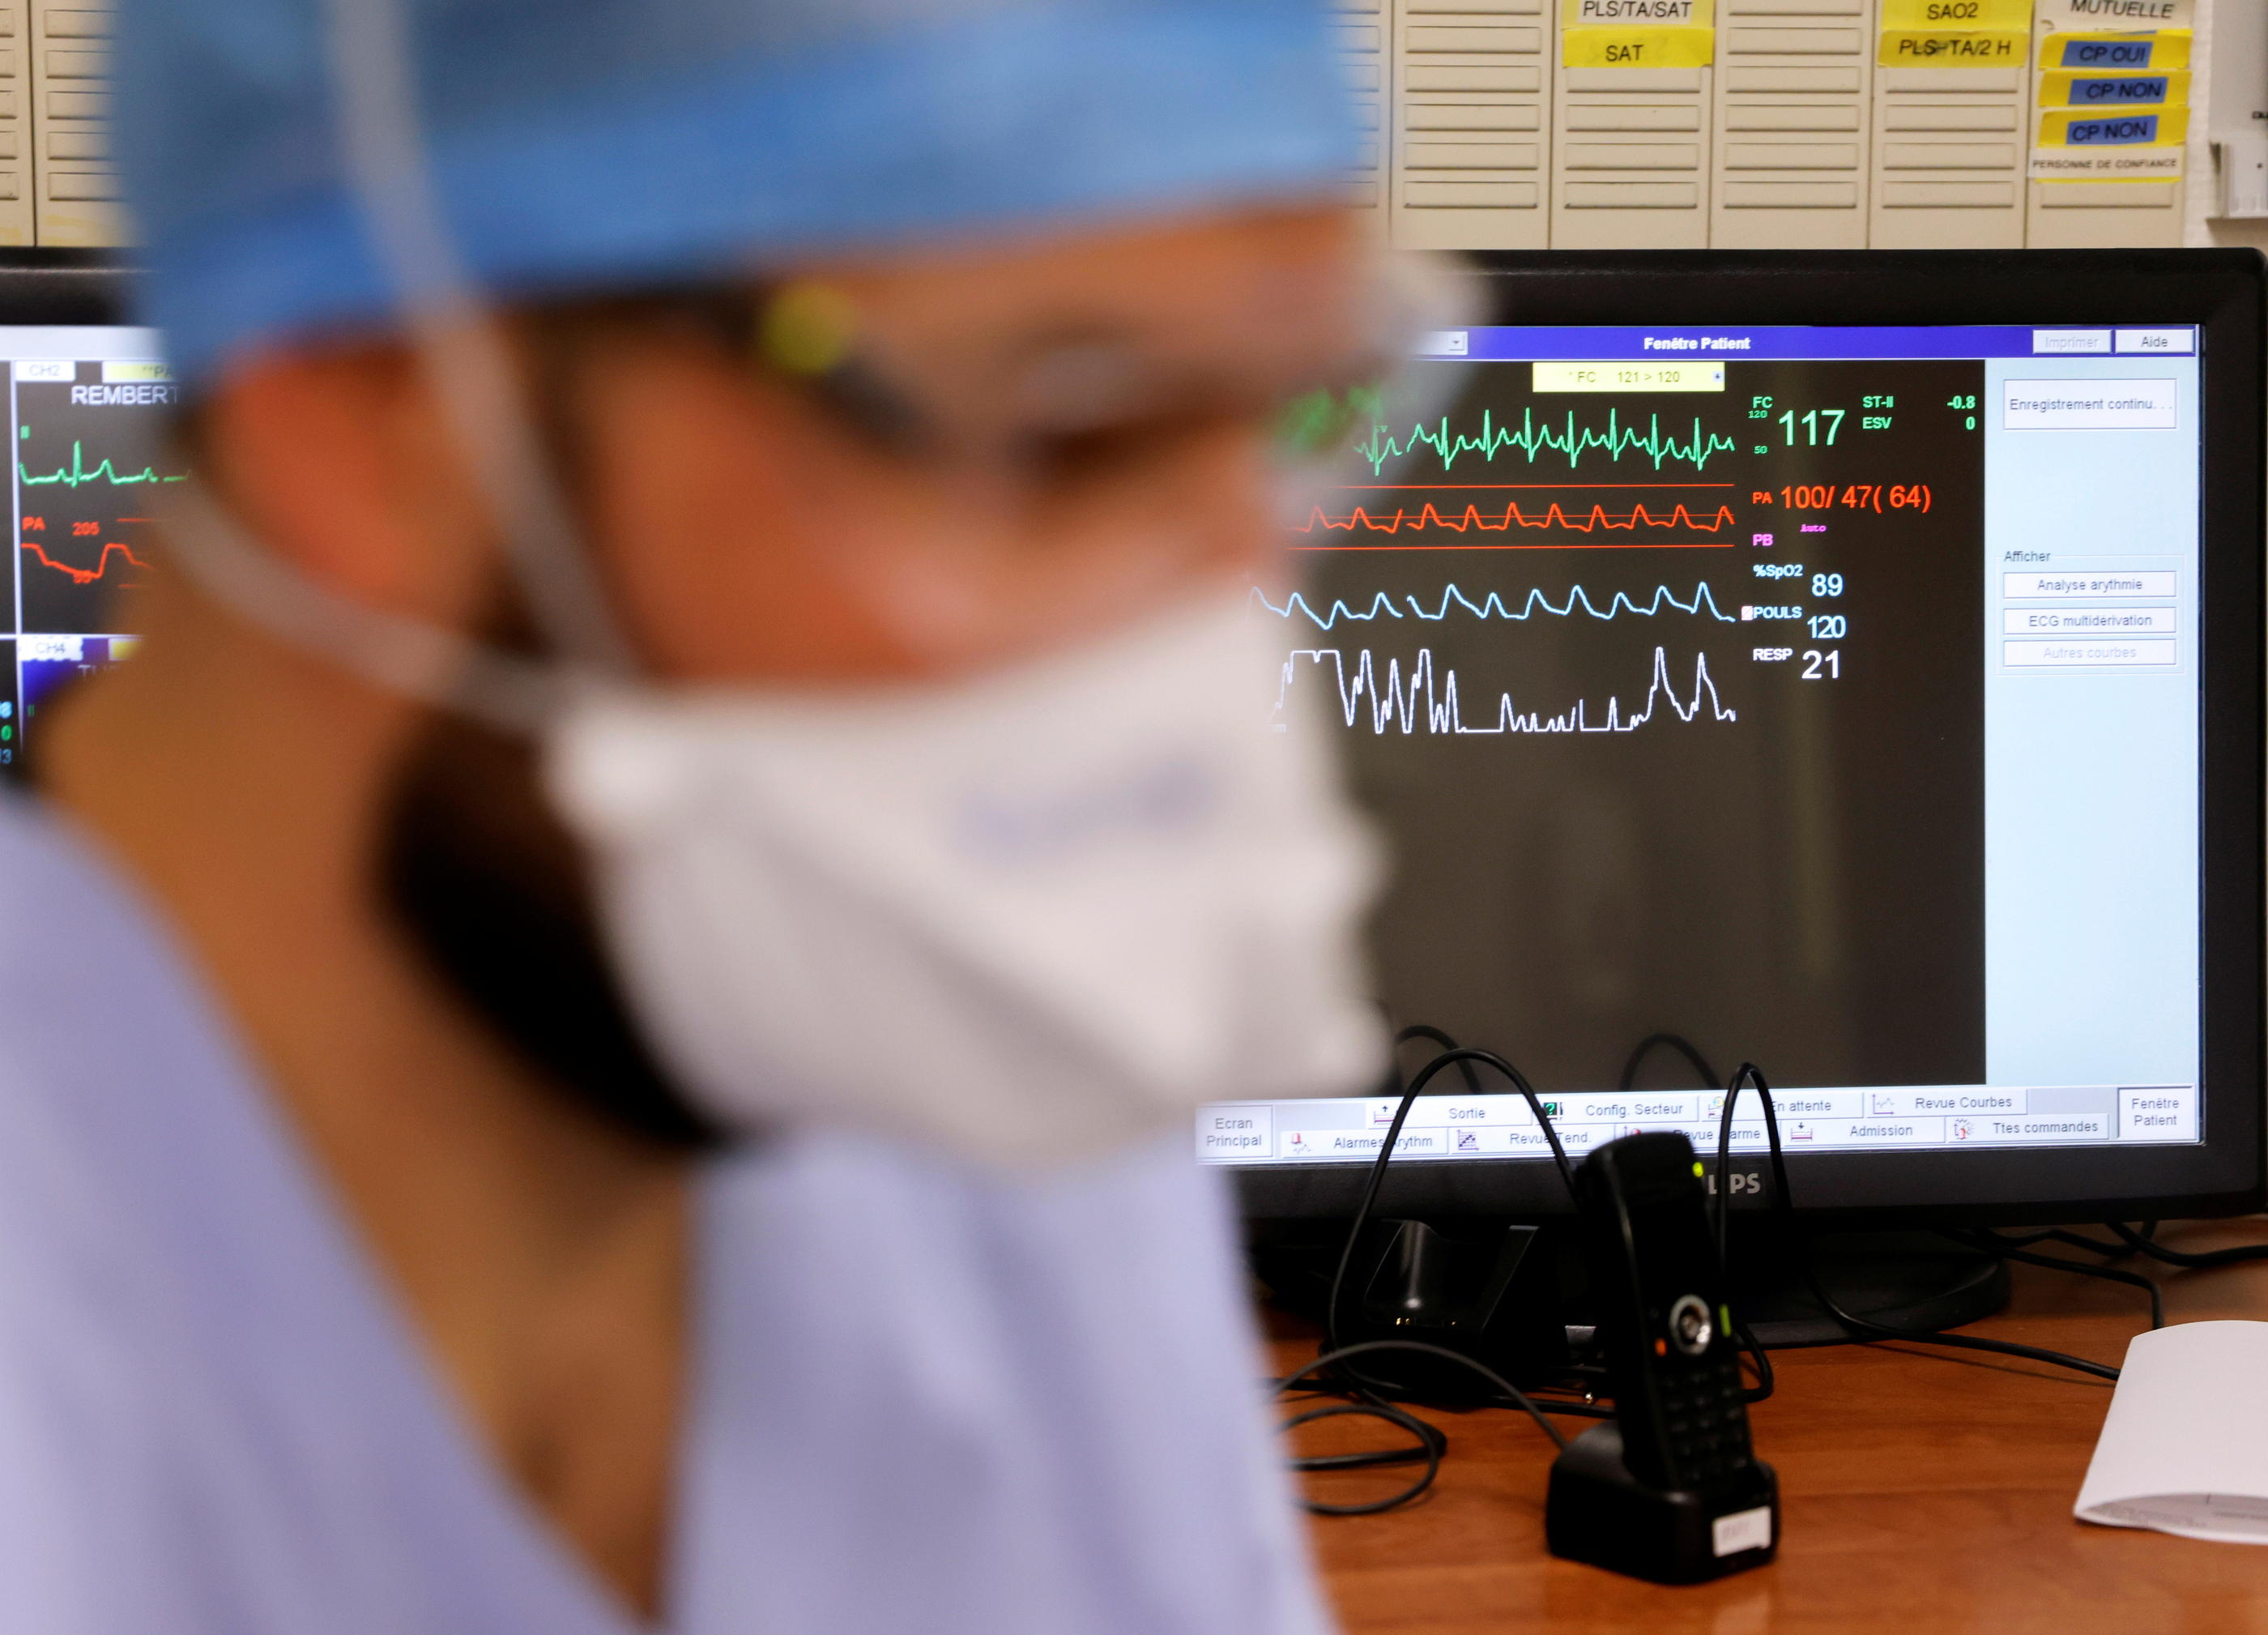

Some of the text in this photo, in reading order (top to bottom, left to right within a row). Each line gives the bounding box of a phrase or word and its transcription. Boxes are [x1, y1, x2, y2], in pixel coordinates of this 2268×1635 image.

[1583, 1, 1693, 17] PLS/TA/SAT
[1927, 2, 1978, 19] SAO2
[2070, 0, 2174, 19] MUTUELLE
[1605, 45, 1643, 62] SAT
[1997, 41, 2011, 55] H
[2079, 46, 2146, 62] CP OUI
[2087, 82, 2162, 99] CP NON
[2072, 122, 2147, 141] CP NON
[2033, 158, 2176, 169] PERSONNE DE CONFIANCE
[1701, 337, 1751, 350] Patient
[2045, 337, 2099, 350] Imprimer
[2141, 336, 2168, 348] Aide
[29, 364, 60, 376] CH2
[1577, 371, 1596, 382] FC
[1618, 371, 1639, 382] 121
[1659, 371, 1681, 382] 120
[1752, 396, 1773, 408] FC
[1947, 395, 1976, 409] -0.8
[2010, 399, 2104, 412] Enregistrement
[1748, 410, 1767, 418] 120
[1779, 409, 1845, 446] 117
[1863, 416, 1975, 430] ESV 0
[1754, 446, 1767, 454] 50
[1752, 492, 1772, 504] PA
[22, 516, 45, 531] PA
[1753, 534, 1773, 546] PB
[2004, 551, 2051, 562] Afficher
[1753, 565, 1844, 596] %SpO2 89
[2038, 578, 2142, 593] Analyse arythmie
[1753, 607, 1846, 638] POULS 120
[2029, 616, 2059, 627] ECG
[2044, 647, 2137, 659] Autres courbes
[1753, 649, 1839, 679] RESP 21
[1789, 1100, 1831, 1112] attente
[1915, 1096, 2012, 1109] Revue Courbes
[1449, 1107, 1486, 1119] Sortie
[1585, 1103, 1683, 1117] Config. Secteur
[1215, 1118, 1253, 1129] Ecran
[1993, 1121, 2099, 1133] Ttes commandes
[2134, 1115, 2177, 1126] Patient
[1850, 1125, 1912, 1137] Admission
[1207, 1134, 1262, 1148] Principal
[1395, 1136, 1432, 1150] rythm
